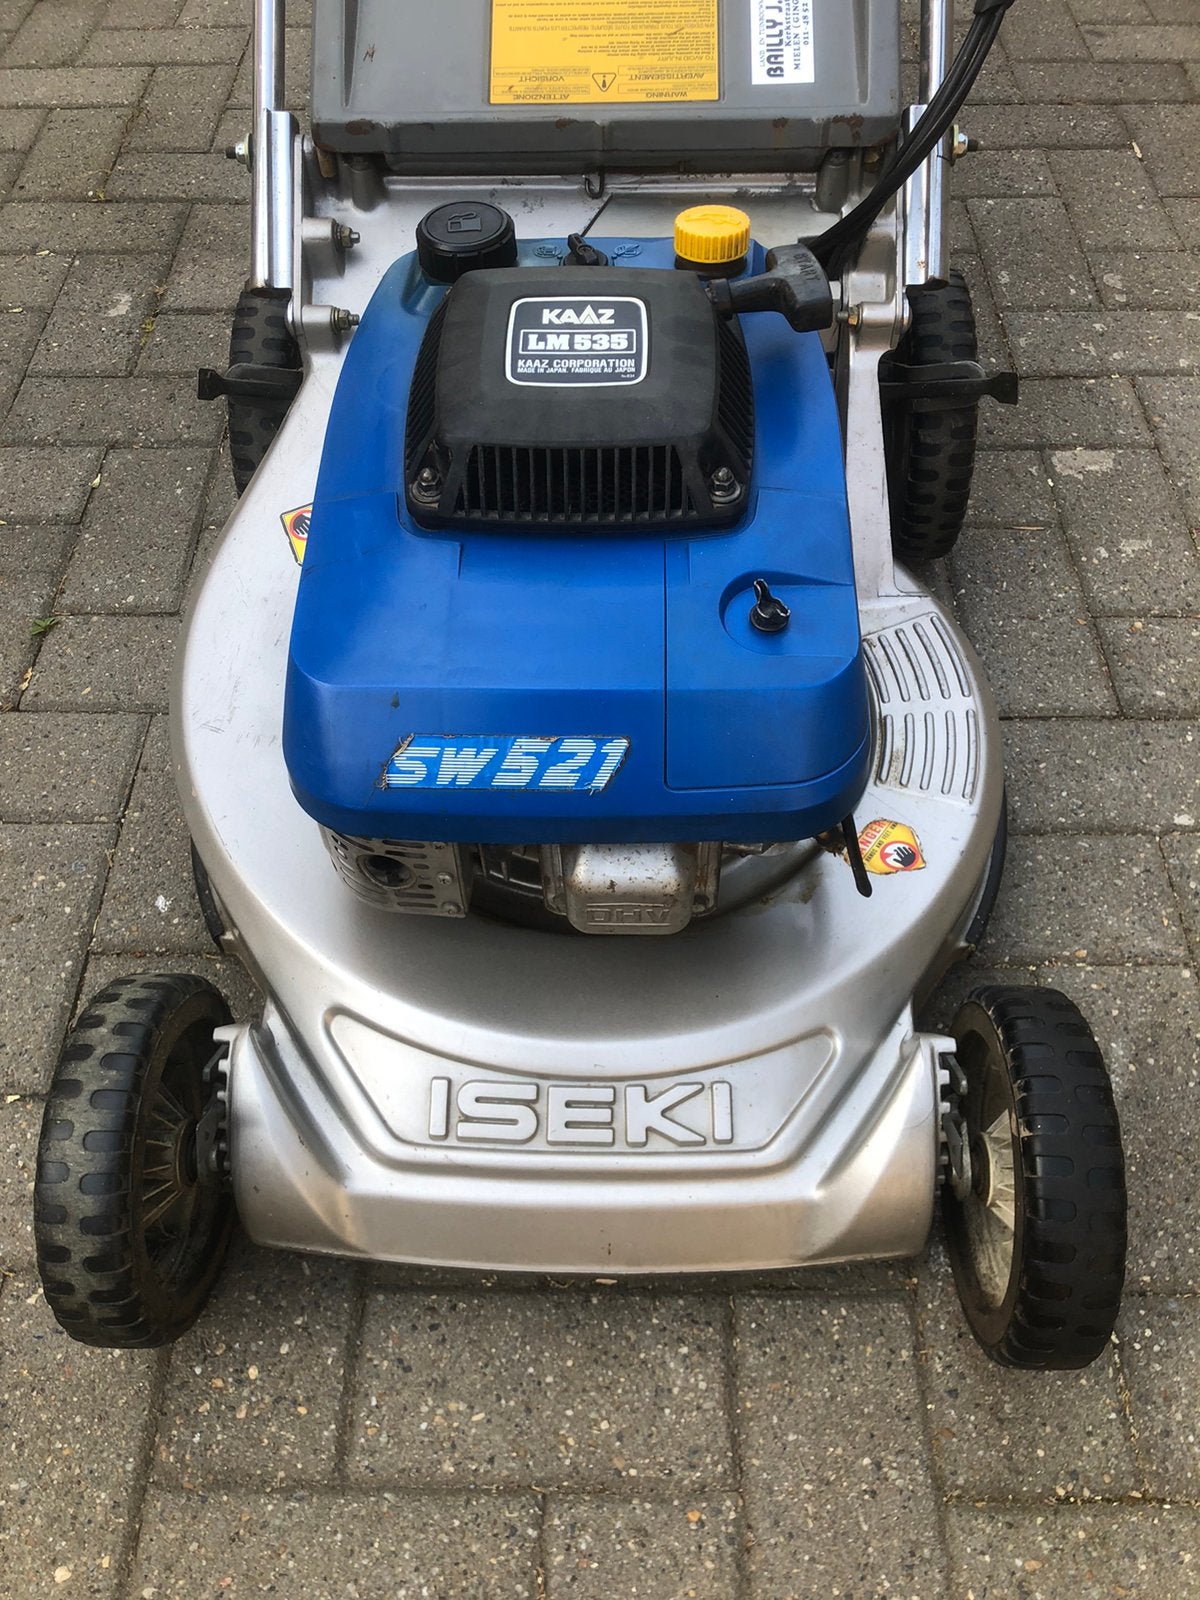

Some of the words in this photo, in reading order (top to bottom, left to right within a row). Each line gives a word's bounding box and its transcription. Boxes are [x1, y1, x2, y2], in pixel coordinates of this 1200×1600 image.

[759, 37, 765, 45] EN
[765, 19, 784, 78] BAILLY
[793, 33, 801, 70] MIELEN
[628, 73, 705, 81] AVERTISSEMENT
[542, 304, 615, 325] KAAZ
[527, 333, 570, 350] LM
[573, 333, 629, 350] 535
[517, 359, 549, 368] KAAZ
[553, 358, 636, 368] CORPORATION
[571, 366, 602, 374] FABRIQUE
[491, 738, 628, 787] 521
[859, 820, 886, 856] ANGER
[586, 908, 670, 922] OHV
[428, 1076, 734, 1147] ISEKI
